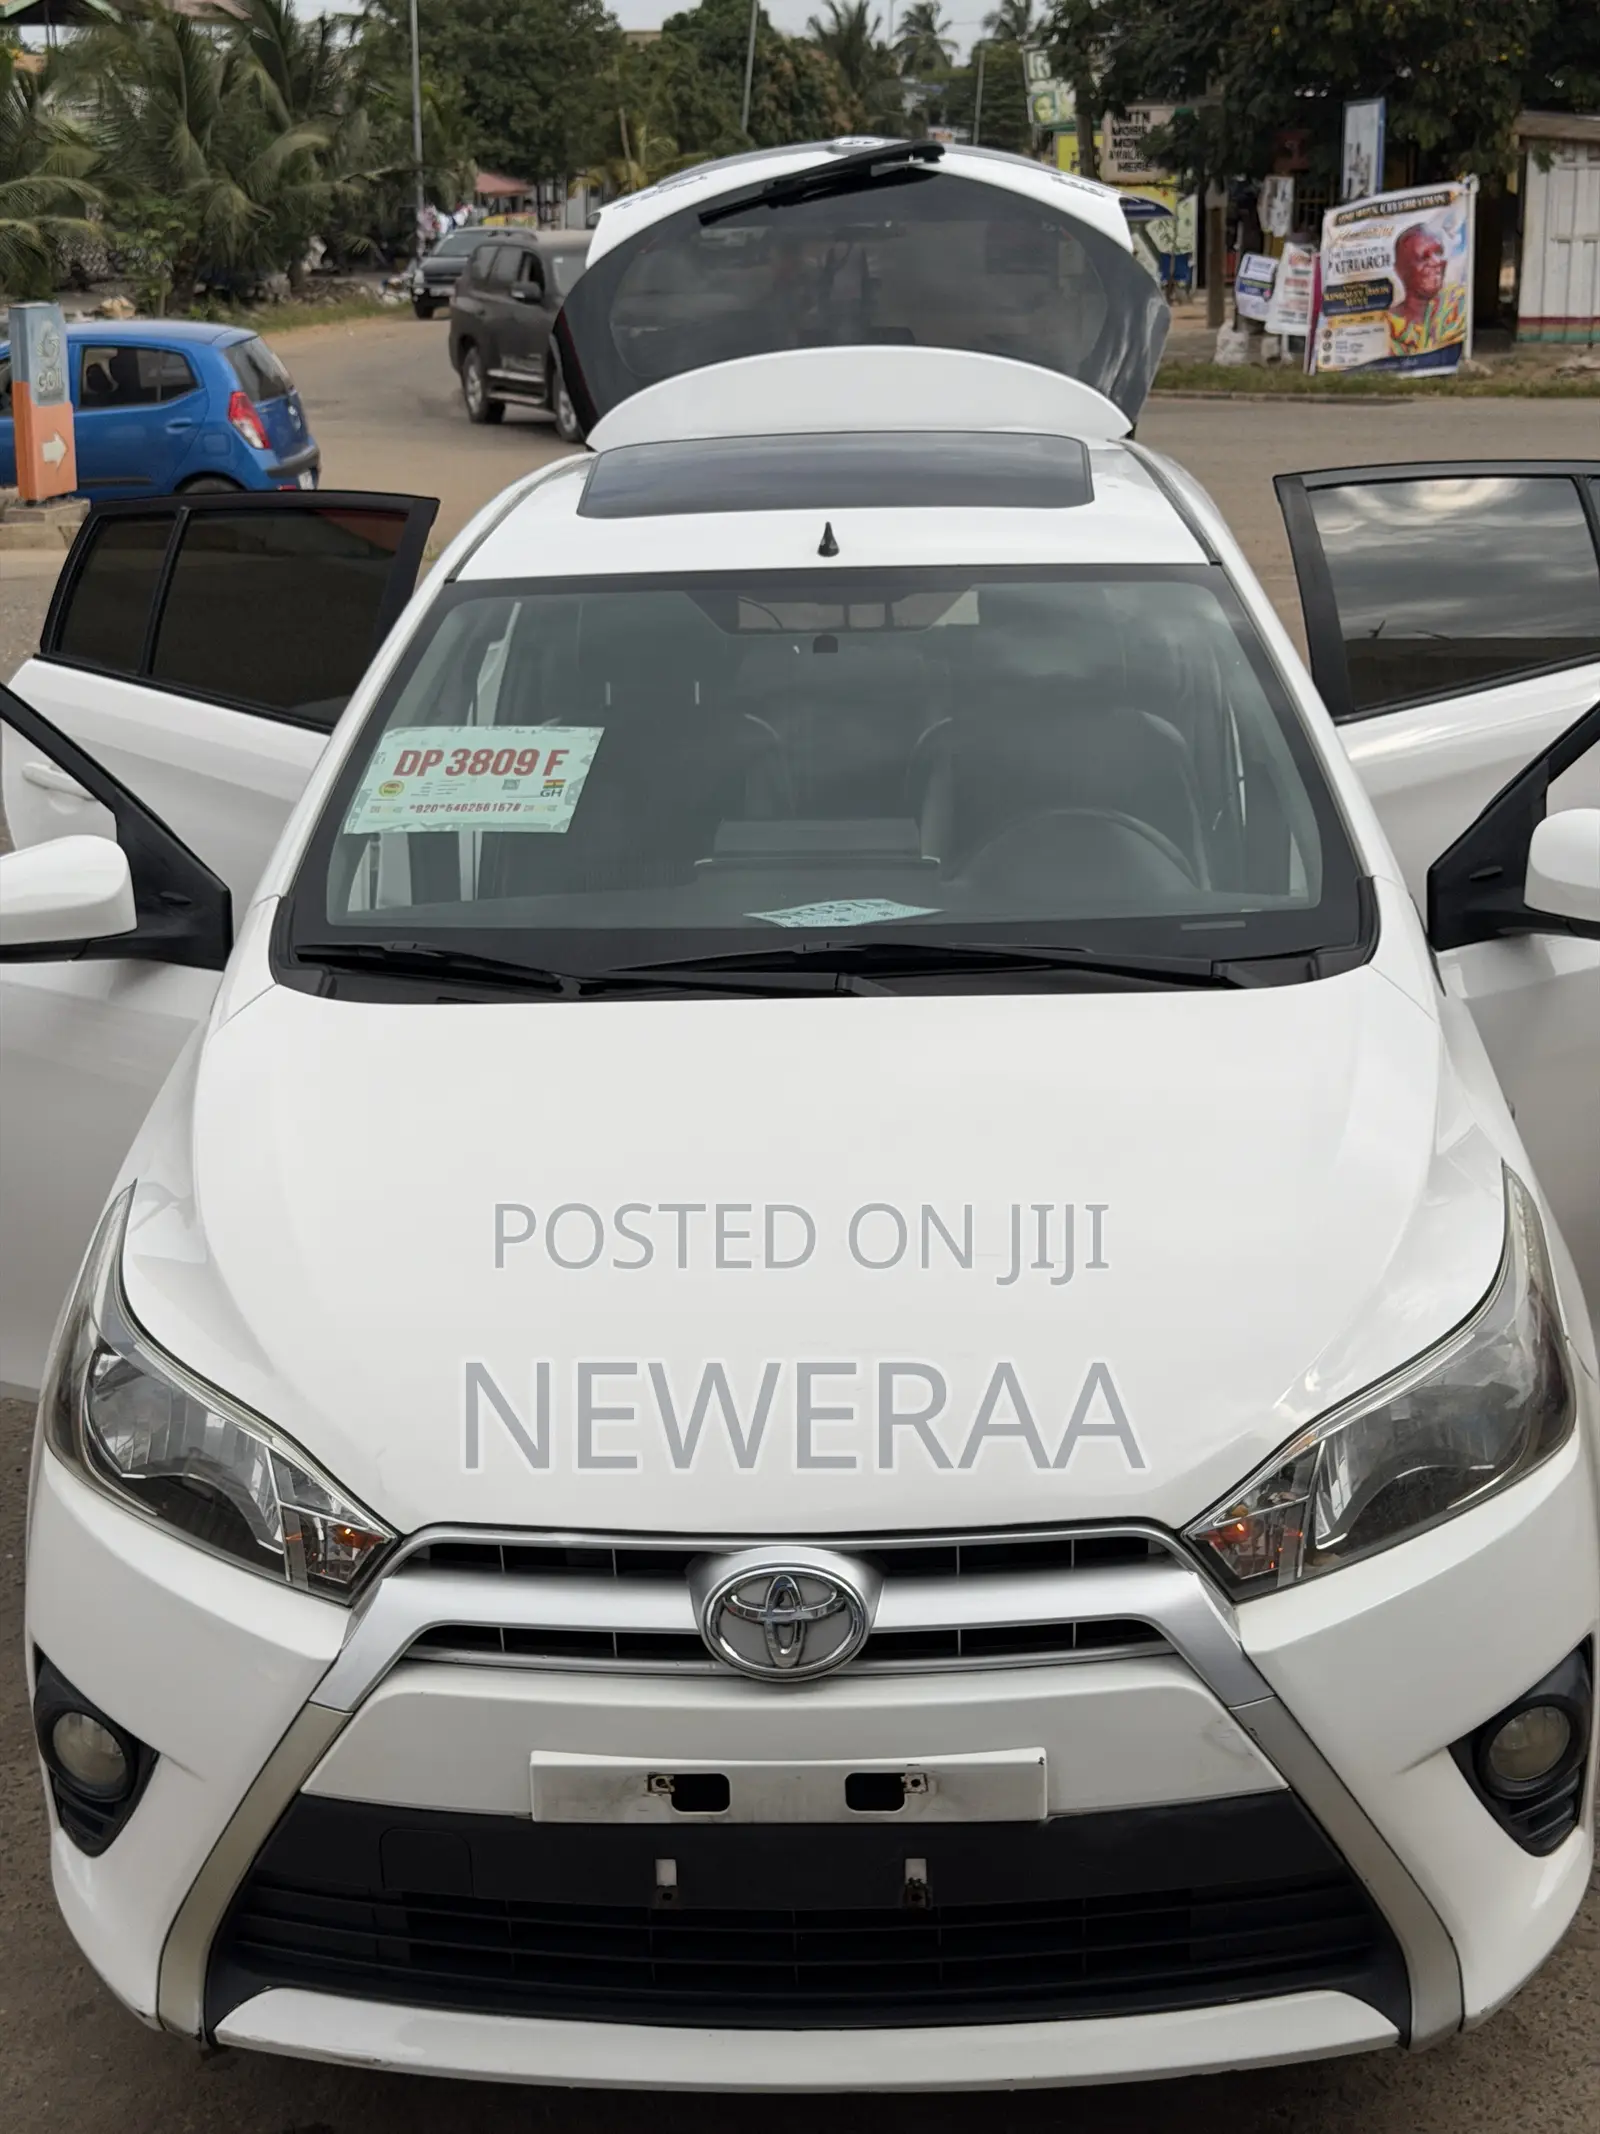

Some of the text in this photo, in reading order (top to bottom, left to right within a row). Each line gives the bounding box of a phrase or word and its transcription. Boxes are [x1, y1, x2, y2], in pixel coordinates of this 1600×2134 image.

[393, 749, 444, 776] DP
[445, 748, 540, 776] 3809
[542, 749, 570, 776] F
[540, 789, 563, 798] GH
